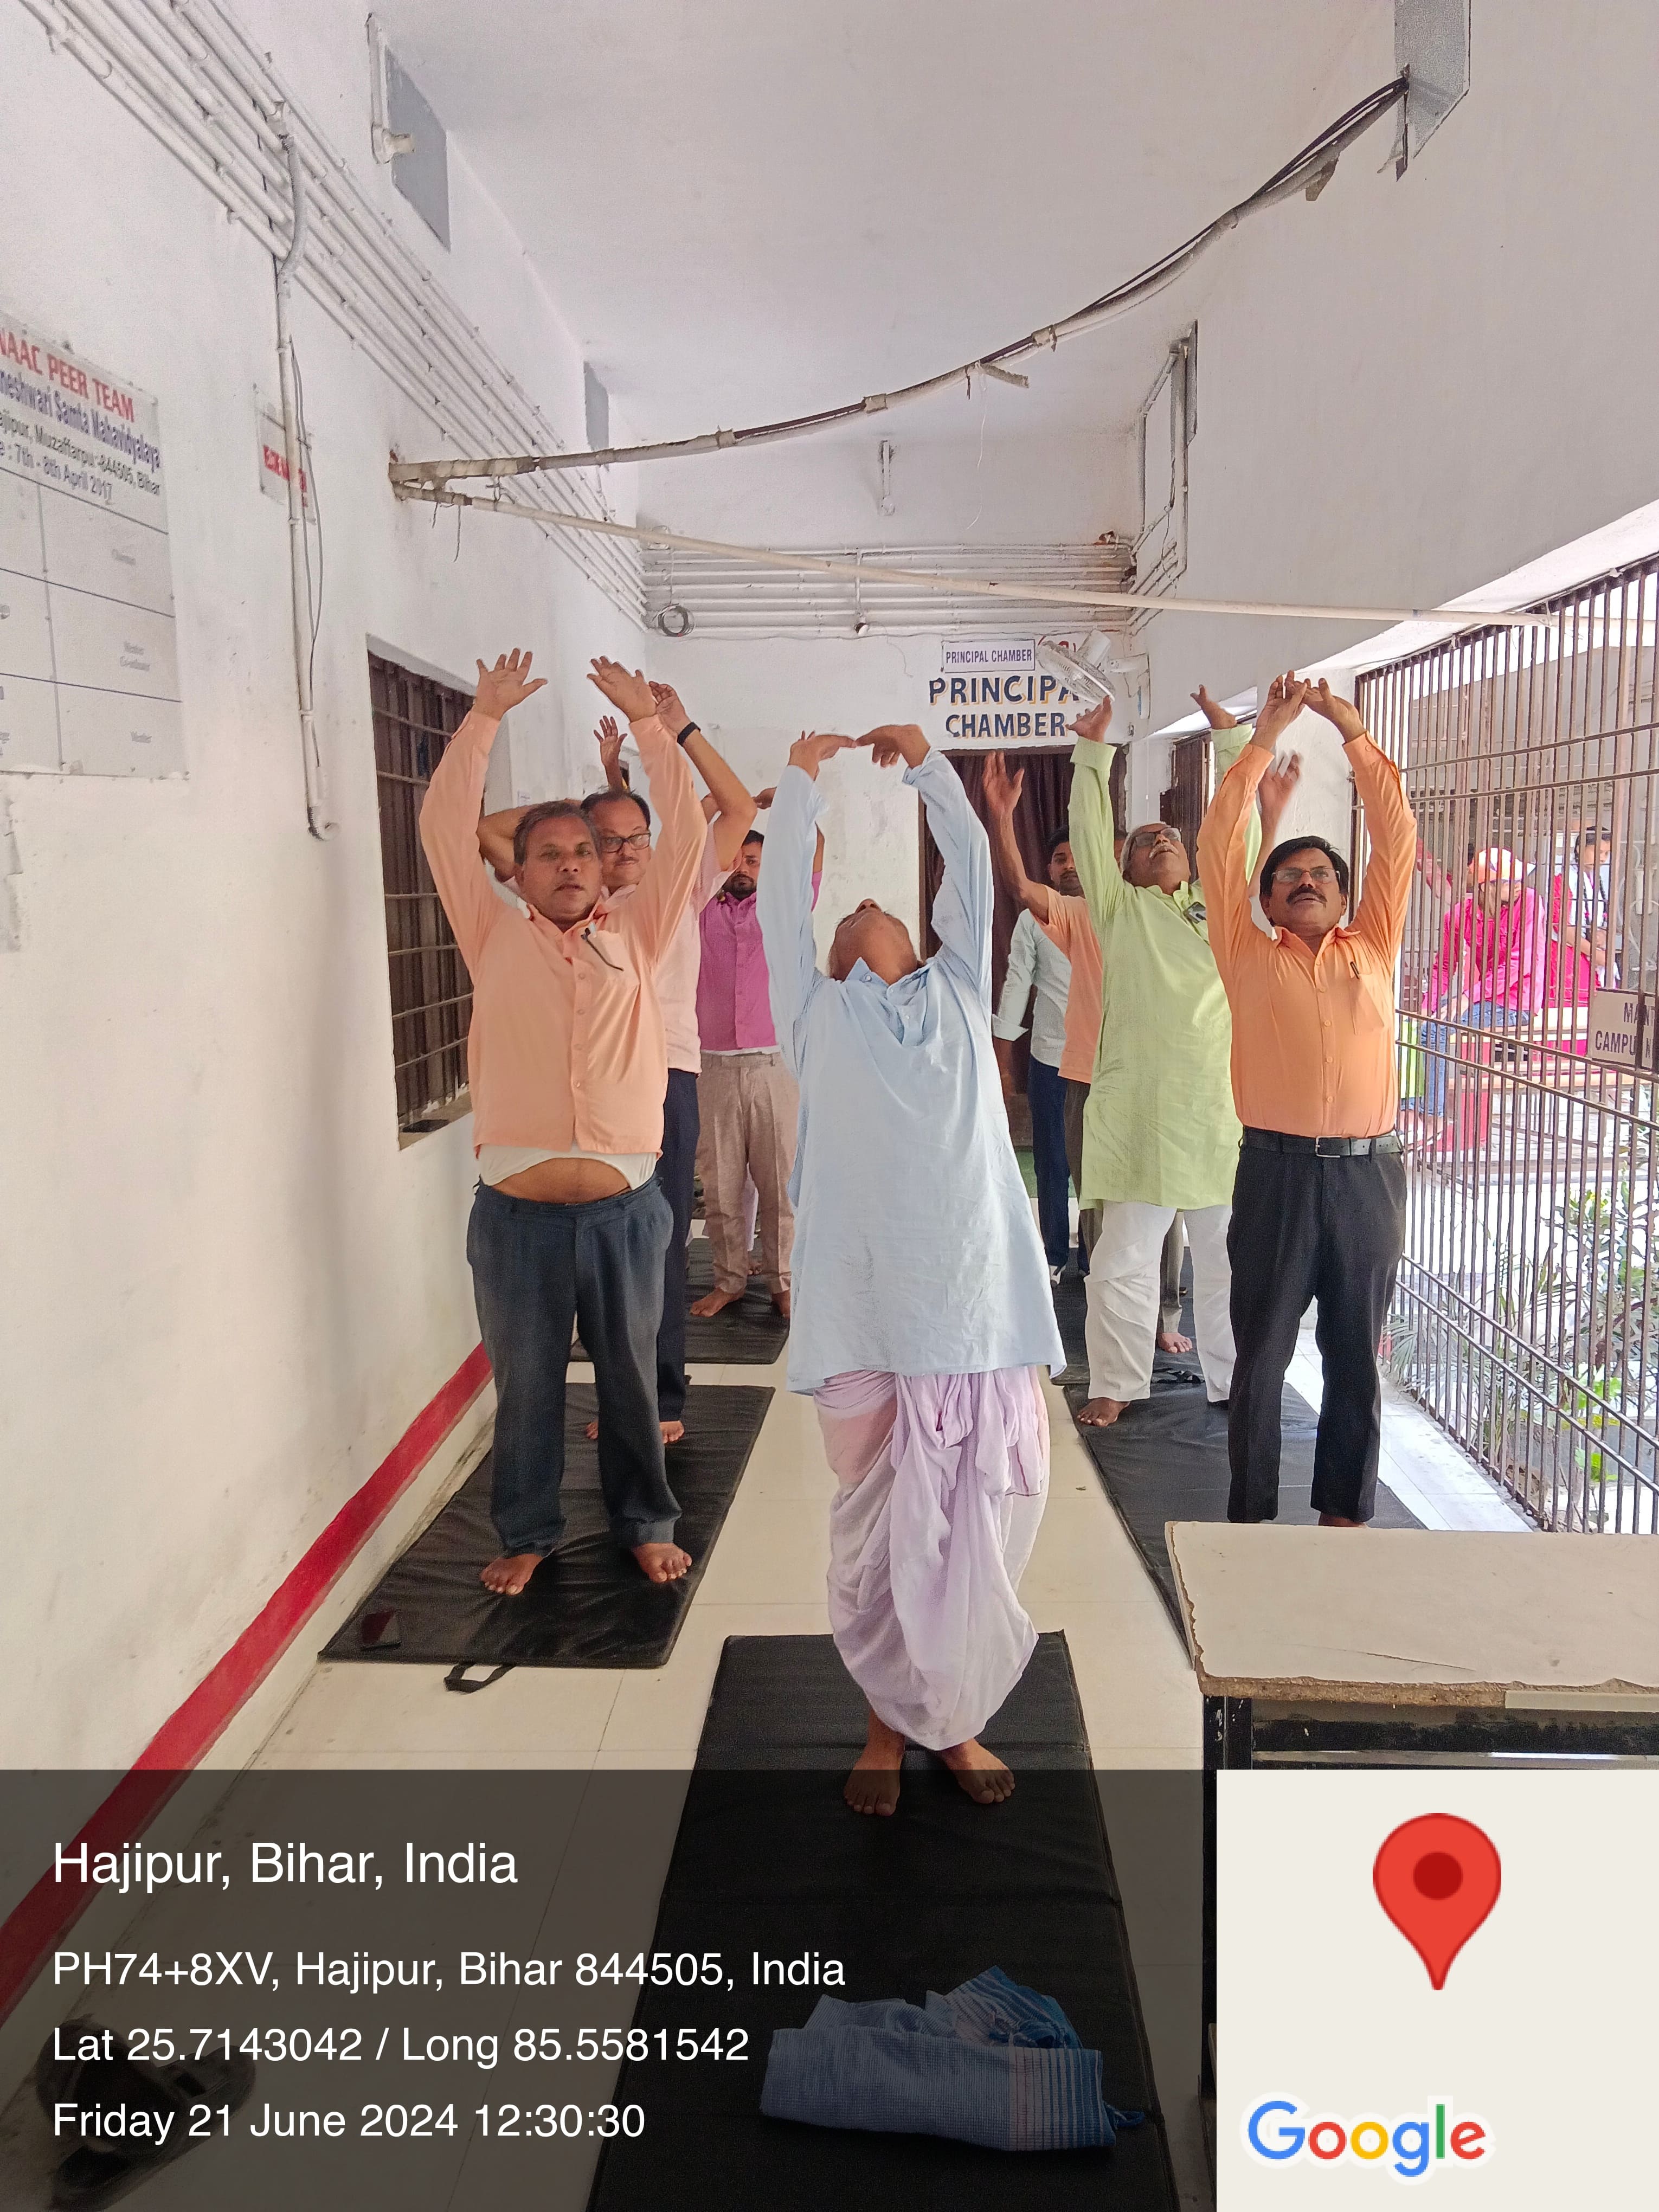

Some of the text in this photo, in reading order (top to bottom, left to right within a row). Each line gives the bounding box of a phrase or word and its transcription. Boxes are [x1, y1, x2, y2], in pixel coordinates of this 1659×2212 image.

[47, 353, 89, 399] PEER
[92, 378, 134, 423] TEAM
[946, 648, 1032, 664] PRINCIPAL CHAMBER
[929, 675, 1081, 704] PRINCIP
[945, 712, 1066, 738] CHAMBER
[1595, 1030, 1638, 1056] CAMPU
